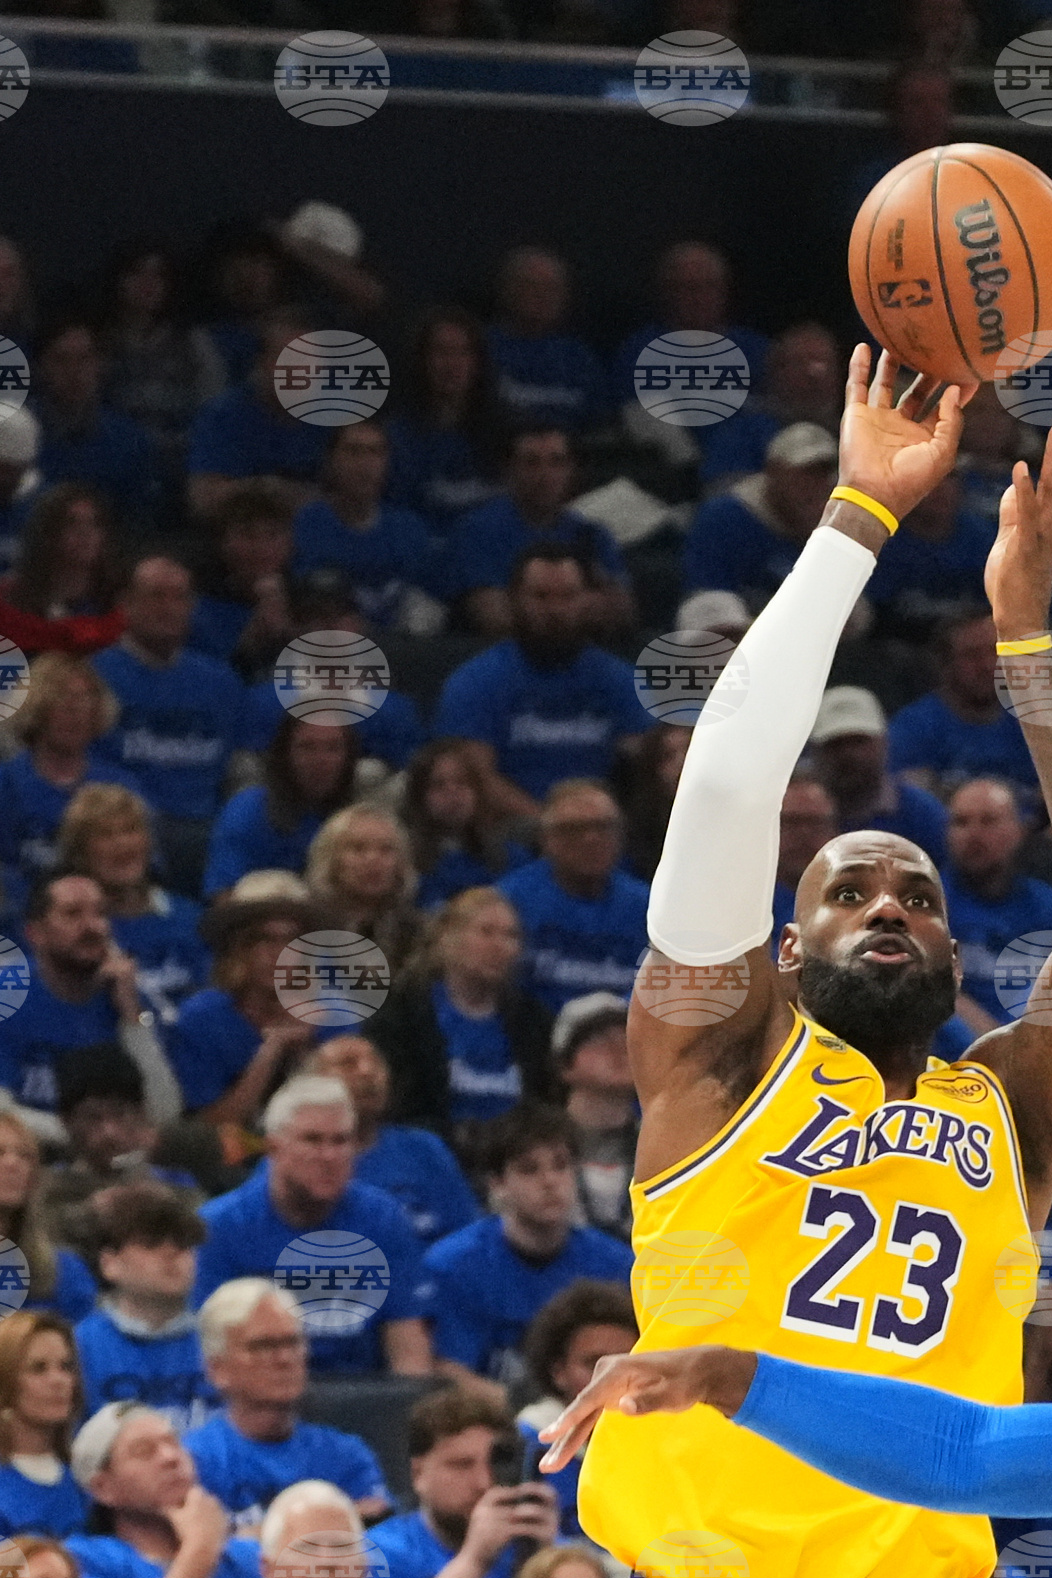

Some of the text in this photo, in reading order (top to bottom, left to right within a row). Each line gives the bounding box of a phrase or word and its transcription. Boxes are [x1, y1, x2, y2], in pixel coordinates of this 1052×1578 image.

[954, 199, 1011, 355] Wilson
[760, 1094, 994, 1191] LAKERS
[780, 1182, 967, 1358] 23
